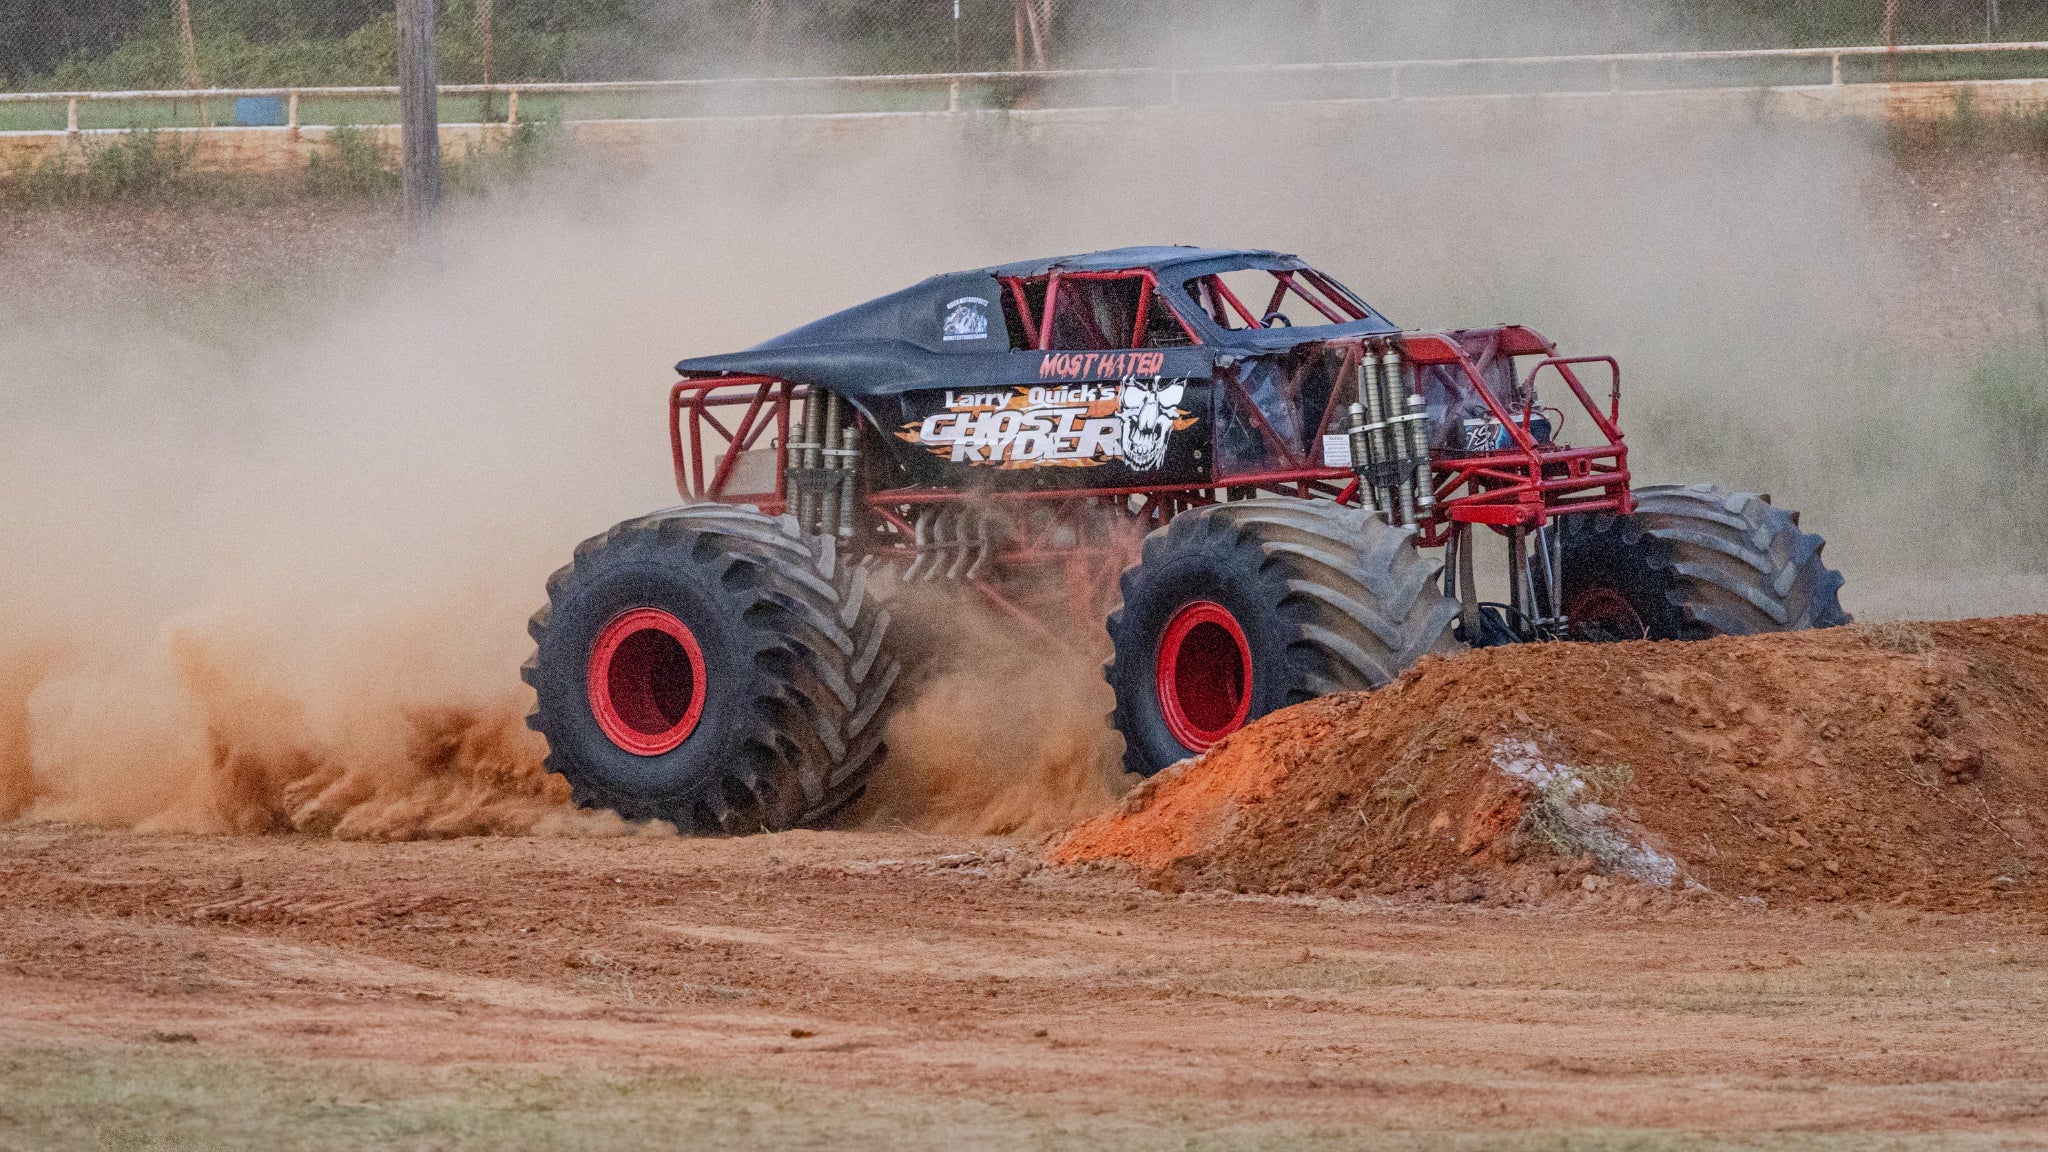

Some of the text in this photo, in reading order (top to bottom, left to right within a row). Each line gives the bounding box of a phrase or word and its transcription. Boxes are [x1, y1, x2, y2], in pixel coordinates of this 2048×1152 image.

[1039, 352, 1165, 379] MOST HATED
[945, 384, 1115, 410] Larry Quick's
[919, 408, 1124, 462] GHOST RYDER
